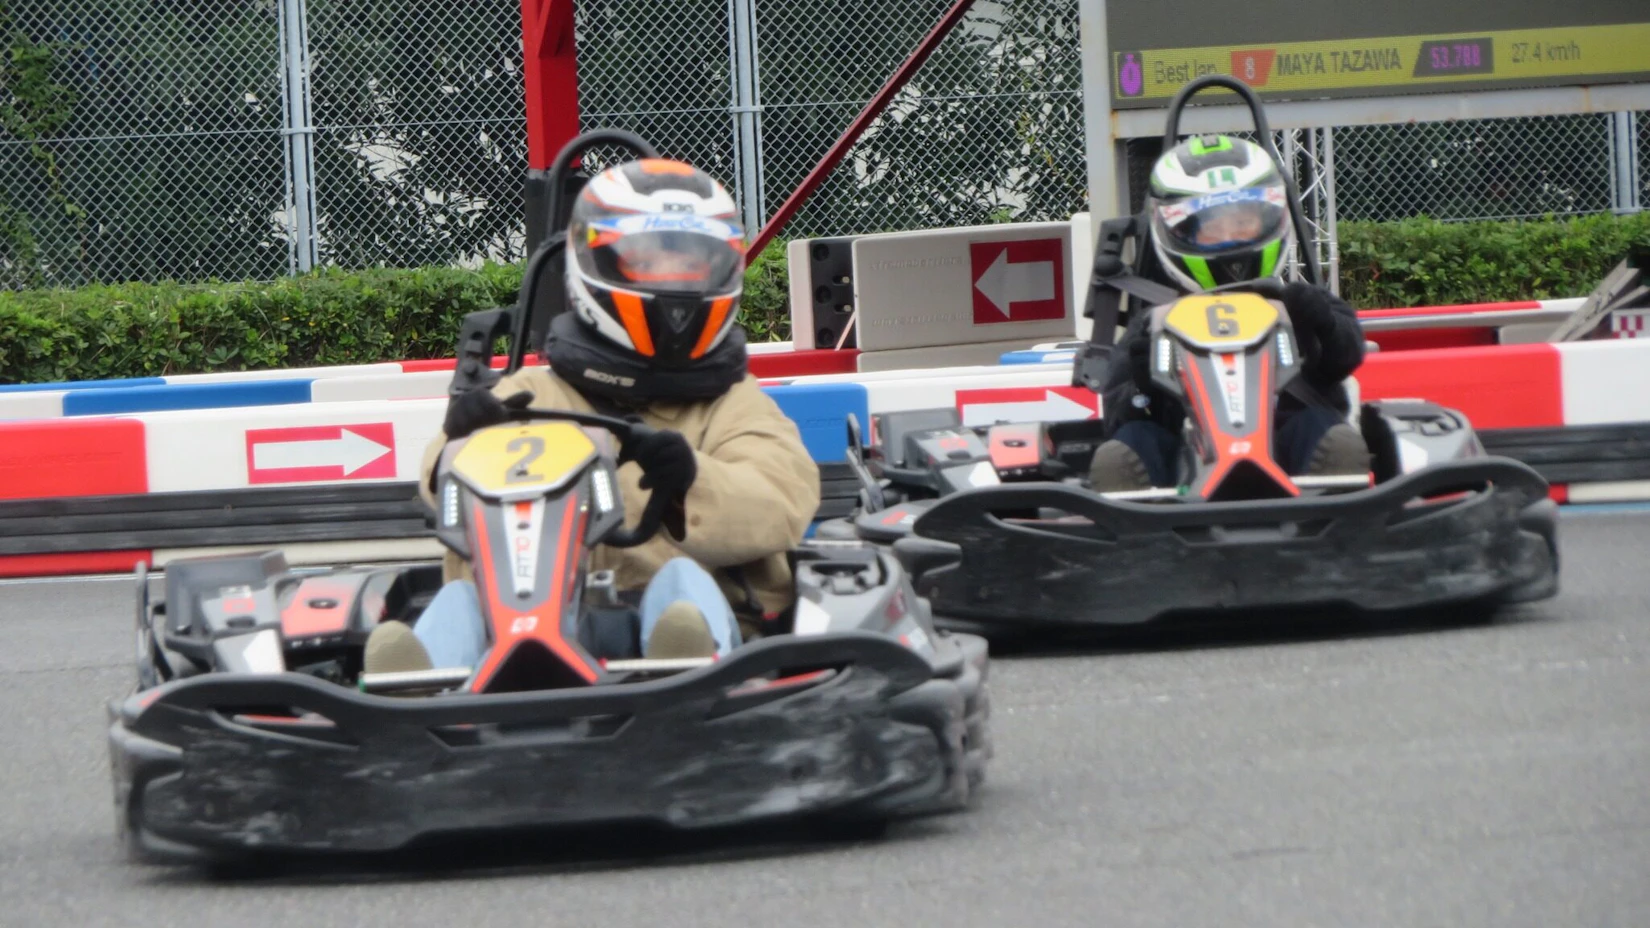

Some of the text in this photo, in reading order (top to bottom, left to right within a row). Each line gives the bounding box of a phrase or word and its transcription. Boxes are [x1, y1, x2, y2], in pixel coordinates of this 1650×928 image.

[1154, 60, 1190, 83] Best
[1277, 52, 1326, 76] MAYA
[1331, 48, 1402, 72] TAZAWA
[1511, 43, 1543, 63] 27.4
[1205, 304, 1240, 337] 6
[505, 436, 545, 484] 2
